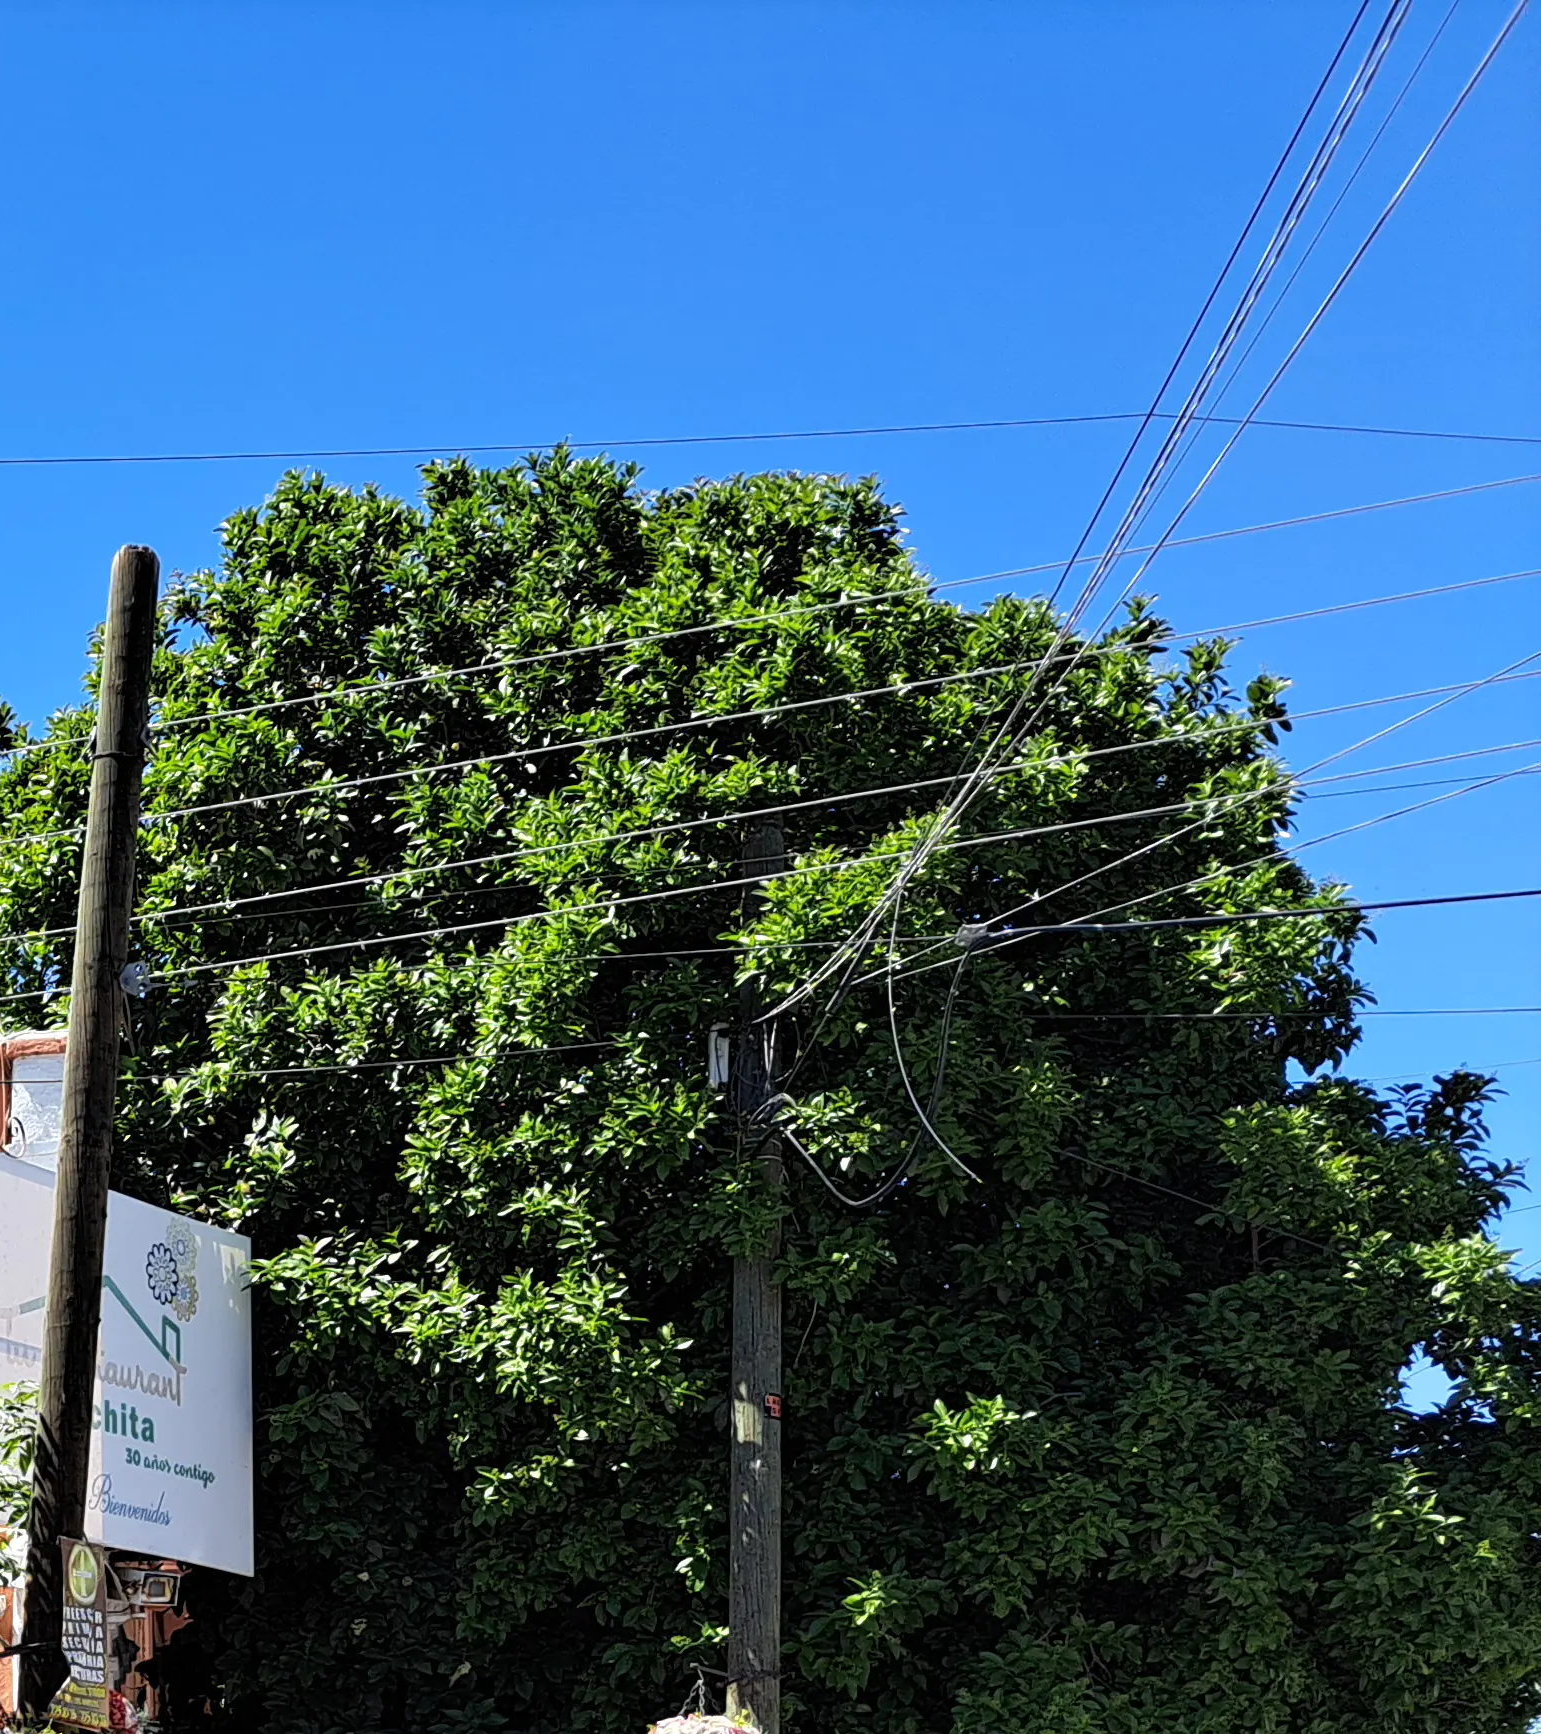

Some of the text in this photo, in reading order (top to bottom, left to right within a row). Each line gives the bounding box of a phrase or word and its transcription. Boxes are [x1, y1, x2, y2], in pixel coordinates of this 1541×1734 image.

[92, 1399, 155, 1444] chita
[125, 1448, 215, 1489] 30 años contigo
[88, 1473, 172, 1526] Bienvenidos
